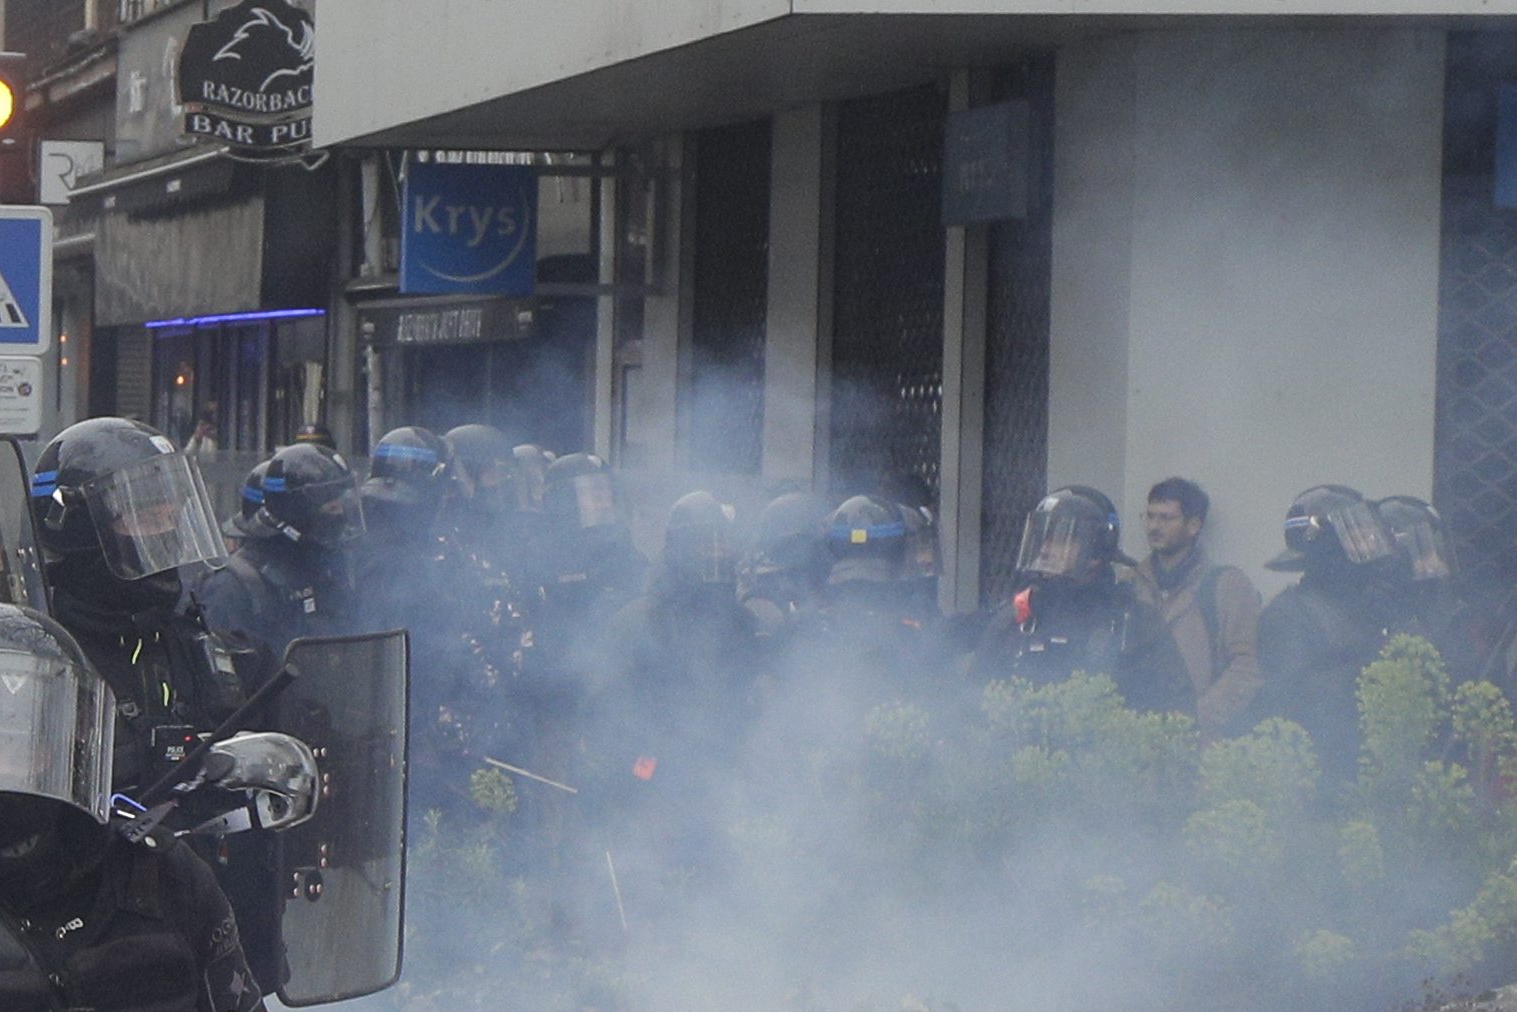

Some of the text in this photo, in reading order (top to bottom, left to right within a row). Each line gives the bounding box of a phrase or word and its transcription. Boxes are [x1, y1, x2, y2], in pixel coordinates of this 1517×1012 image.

[203, 80, 310, 112] RAZORBAC
[193, 114, 308, 144] BAR PU
[414, 195, 516, 248] Krys
